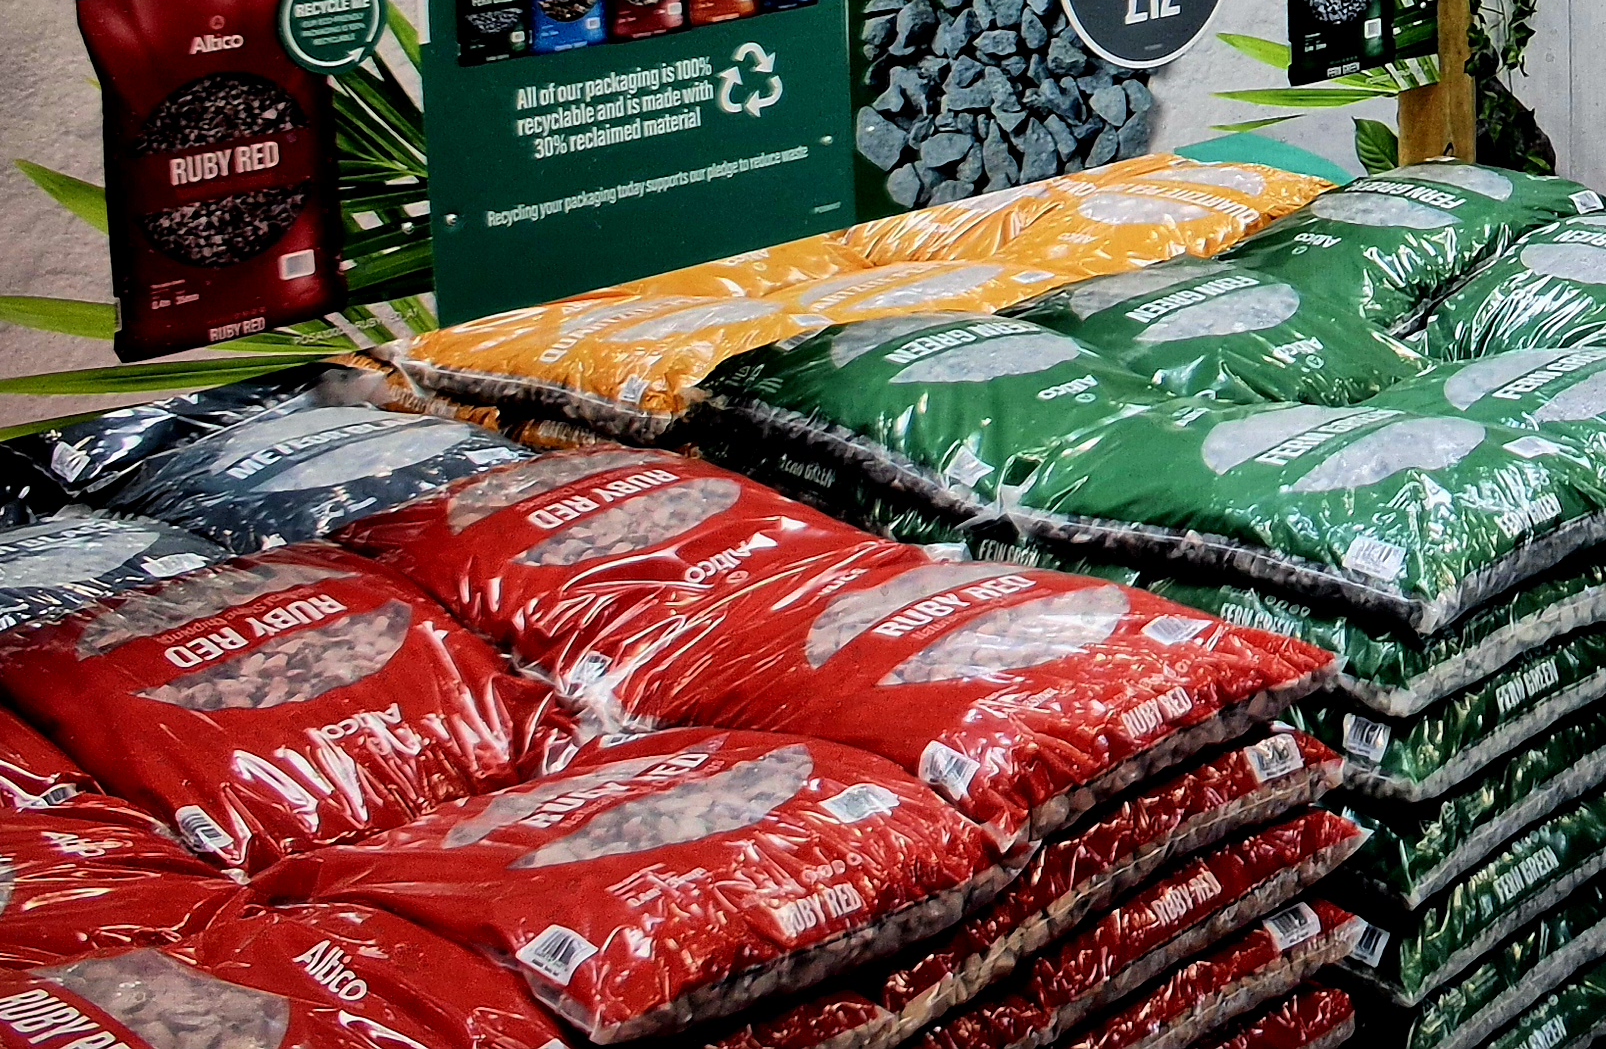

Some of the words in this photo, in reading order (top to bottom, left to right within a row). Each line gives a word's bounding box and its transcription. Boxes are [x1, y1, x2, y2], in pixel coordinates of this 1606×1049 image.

[189, 33, 244, 55] Altico
[516, 86, 537, 110] All
[539, 86, 556, 106] of
[557, 80, 584, 103] our
[584, 67, 660, 100] packaging
[660, 62, 674, 83] is
[674, 56, 713, 81] 100%
[516, 100, 595, 136] recyclable
[597, 96, 624, 119] and
[626, 94, 640, 115] is
[641, 87, 681, 113] made
[681, 80, 715, 104] with
[534, 134, 568, 160] 30%
[569, 117, 641, 152] reclaimed
[643, 105, 702, 136] material
[169, 149, 232, 186] RUBY
[234, 141, 280, 173] RED
[486, 202, 539, 228] Recycling
[540, 199, 564, 219] your
[564, 187, 617, 215] packaging
[617, 179, 646, 202] today
[646, 171, 690, 196] supports
[690, 169, 706, 184] our
[706, 160, 739, 183] pledge
[739, 157, 750, 172] to
[750, 150, 781, 170] reduce
[781, 144, 809, 164] waste
[1125, 283, 1204, 324] GREEN
[1203, 275, 1260, 299] FERN
[209, 322, 242, 342] RUBY
[242, 317, 266, 335] RED
[1037, 373, 1099, 401] Altico
[599, 468, 681, 504] RUBY
[527, 494, 600, 530] RED
[244, 593, 348, 638] RUBY
[872, 588, 971, 639] RUBY
[964, 573, 1039, 601] RED
[164, 624, 249, 669] RED
[1121, 701, 1165, 739] RUBY
[1161, 686, 1194, 721] RED
[293, 938, 368, 1002] Altico
